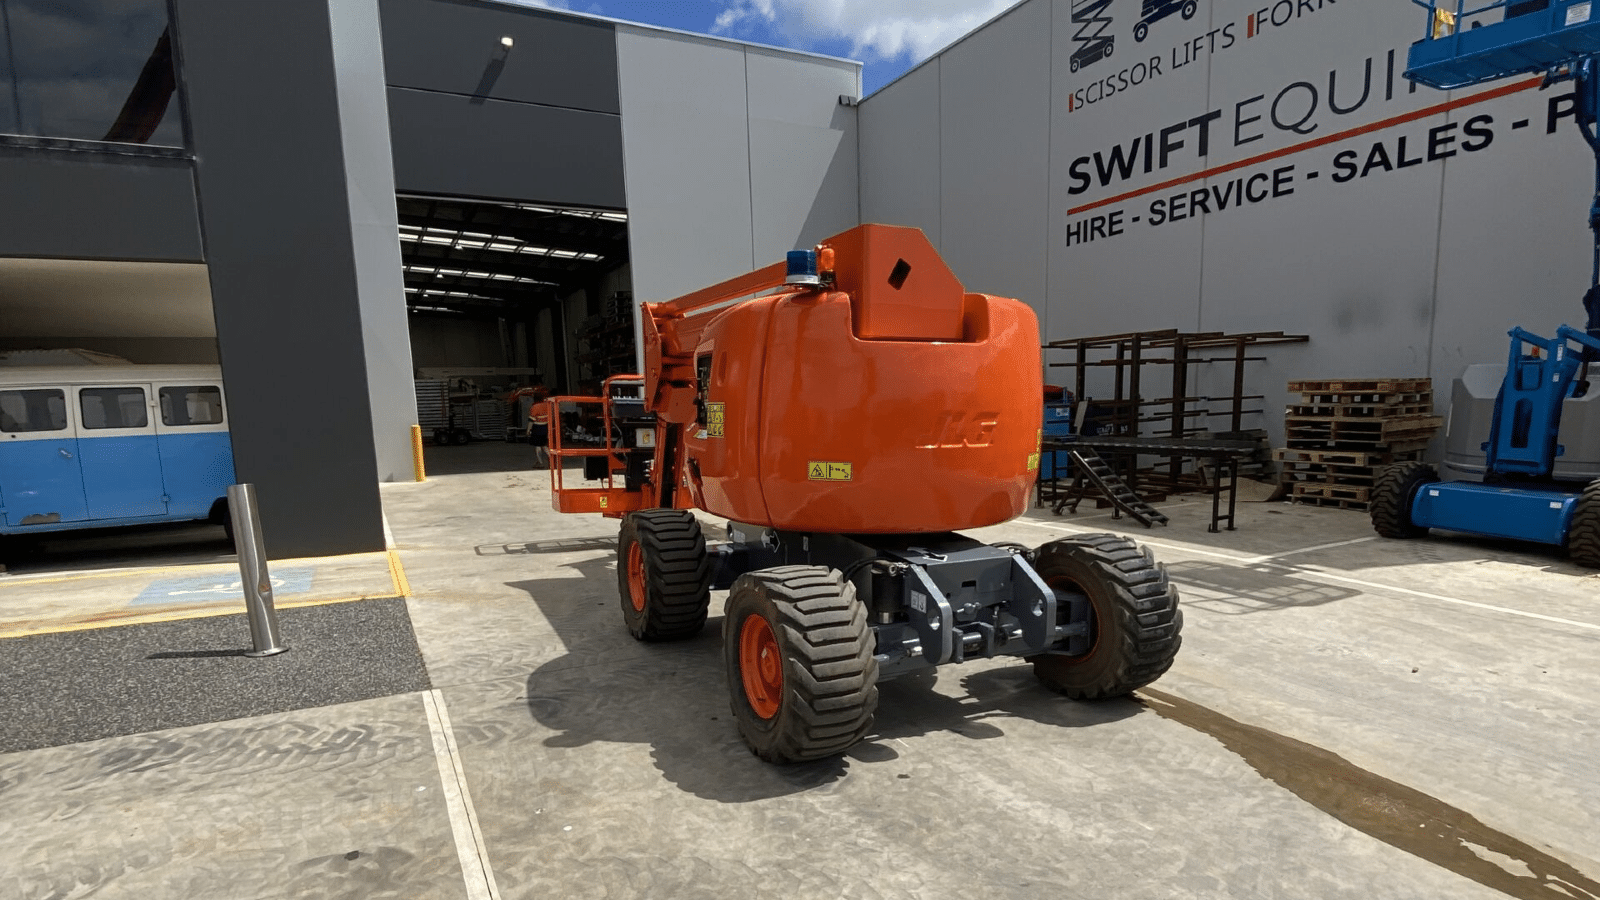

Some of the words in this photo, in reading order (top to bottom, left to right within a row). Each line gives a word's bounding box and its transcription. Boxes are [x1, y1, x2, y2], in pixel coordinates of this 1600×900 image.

[1067, 109, 1222, 195] SWIFT
[1234, 49, 1416, 147] EQUI
[1074, 56, 1162, 110] SCISSOR
[1172, 22, 1236, 69] LIFTS
[1066, 210, 1124, 247] HIRE
[1148, 164, 1295, 226] SERVICE
[1331, 114, 1494, 183] SALES
